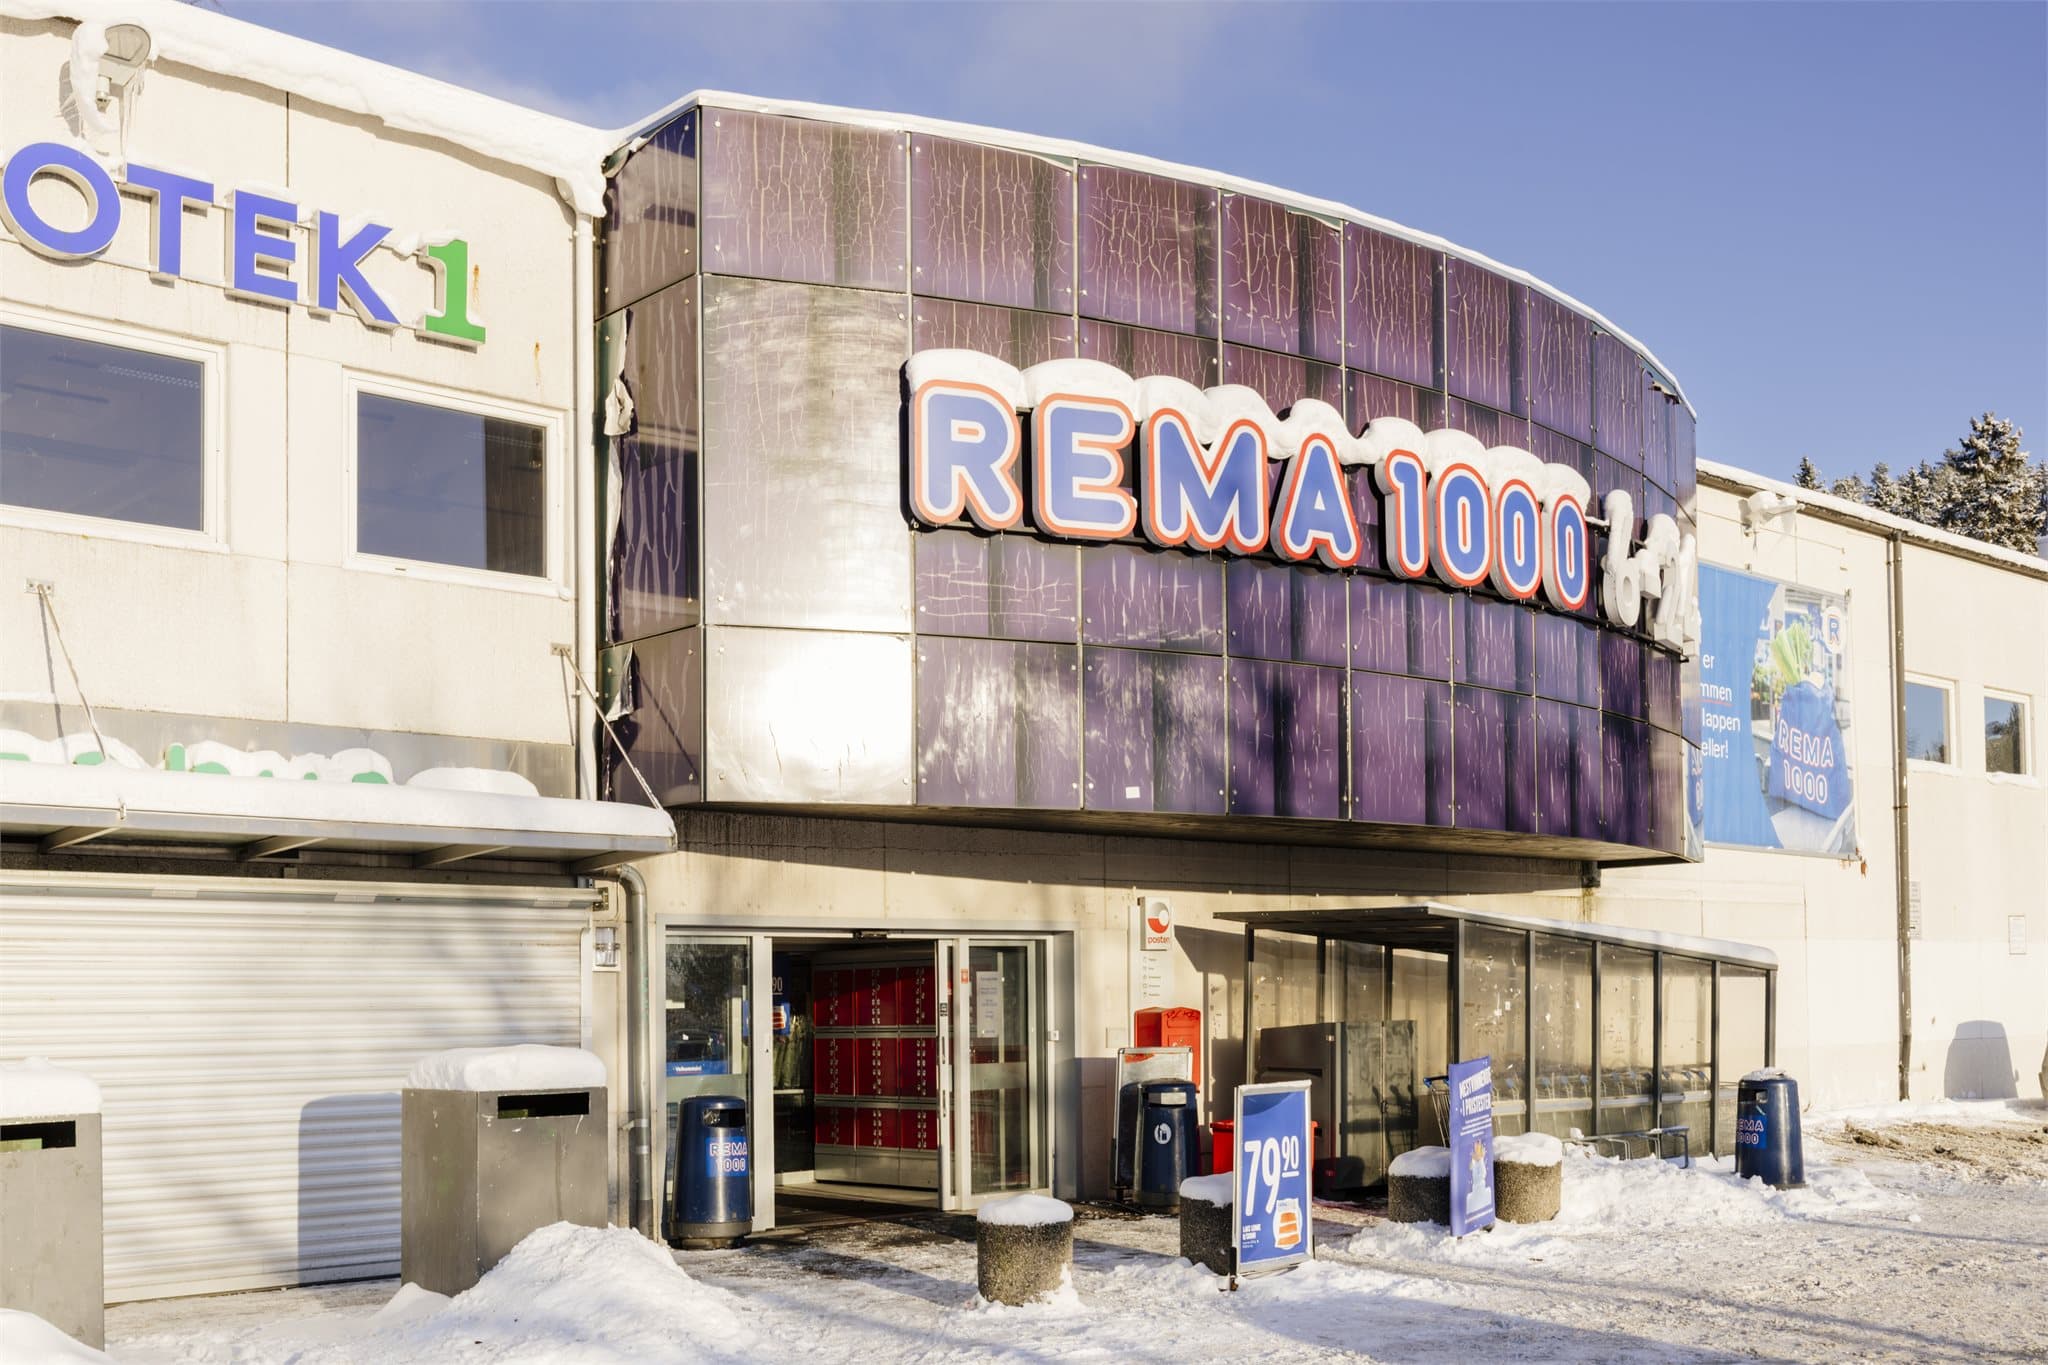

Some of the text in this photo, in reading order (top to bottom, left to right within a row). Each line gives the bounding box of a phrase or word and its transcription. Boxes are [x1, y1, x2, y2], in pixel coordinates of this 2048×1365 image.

[912, 379, 1590, 611] REMA 1000
[1702, 654, 1715, 669] er
[1778, 719, 1834, 768] REMA
[1783, 759, 1829, 804] 1000
[709, 1142, 747, 1157] REMA
[1244, 1135, 1300, 1217] 79 90
